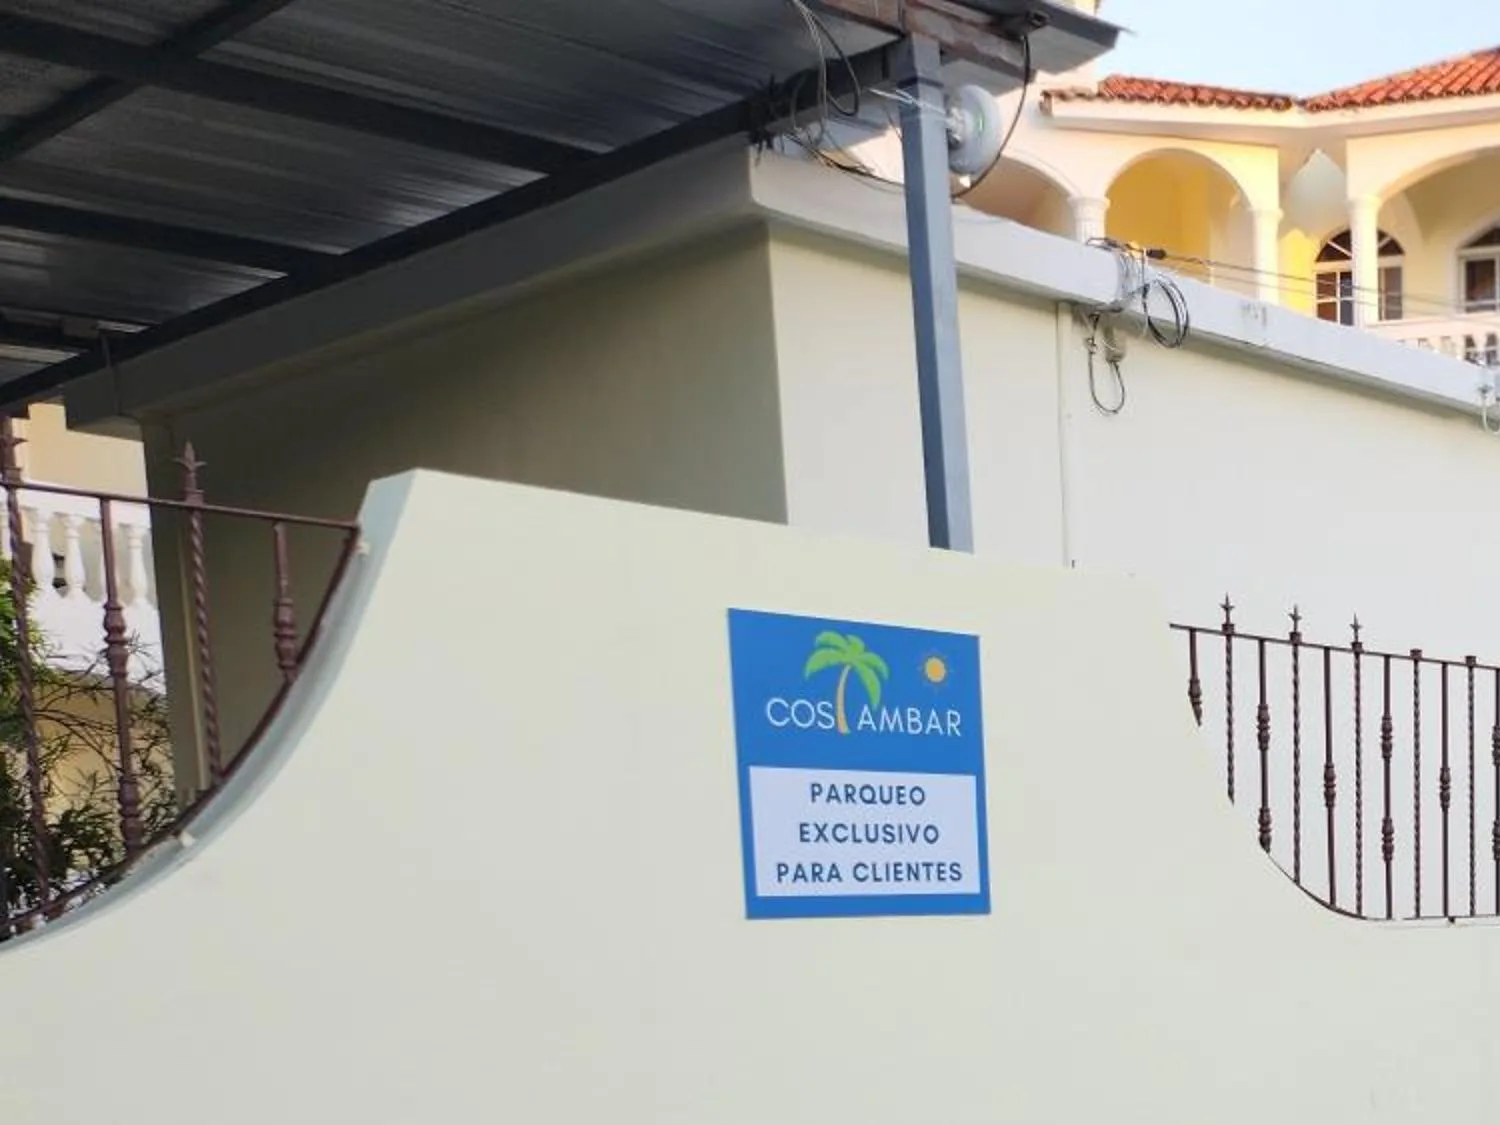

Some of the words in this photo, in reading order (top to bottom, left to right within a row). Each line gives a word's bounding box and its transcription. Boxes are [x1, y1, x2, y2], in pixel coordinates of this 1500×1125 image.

[810, 783, 926, 805] PARQUEO
[799, 823, 940, 844] EXCLUSIVO
[776, 862, 843, 883] PARA
[852, 862, 963, 882] CLIENTES
